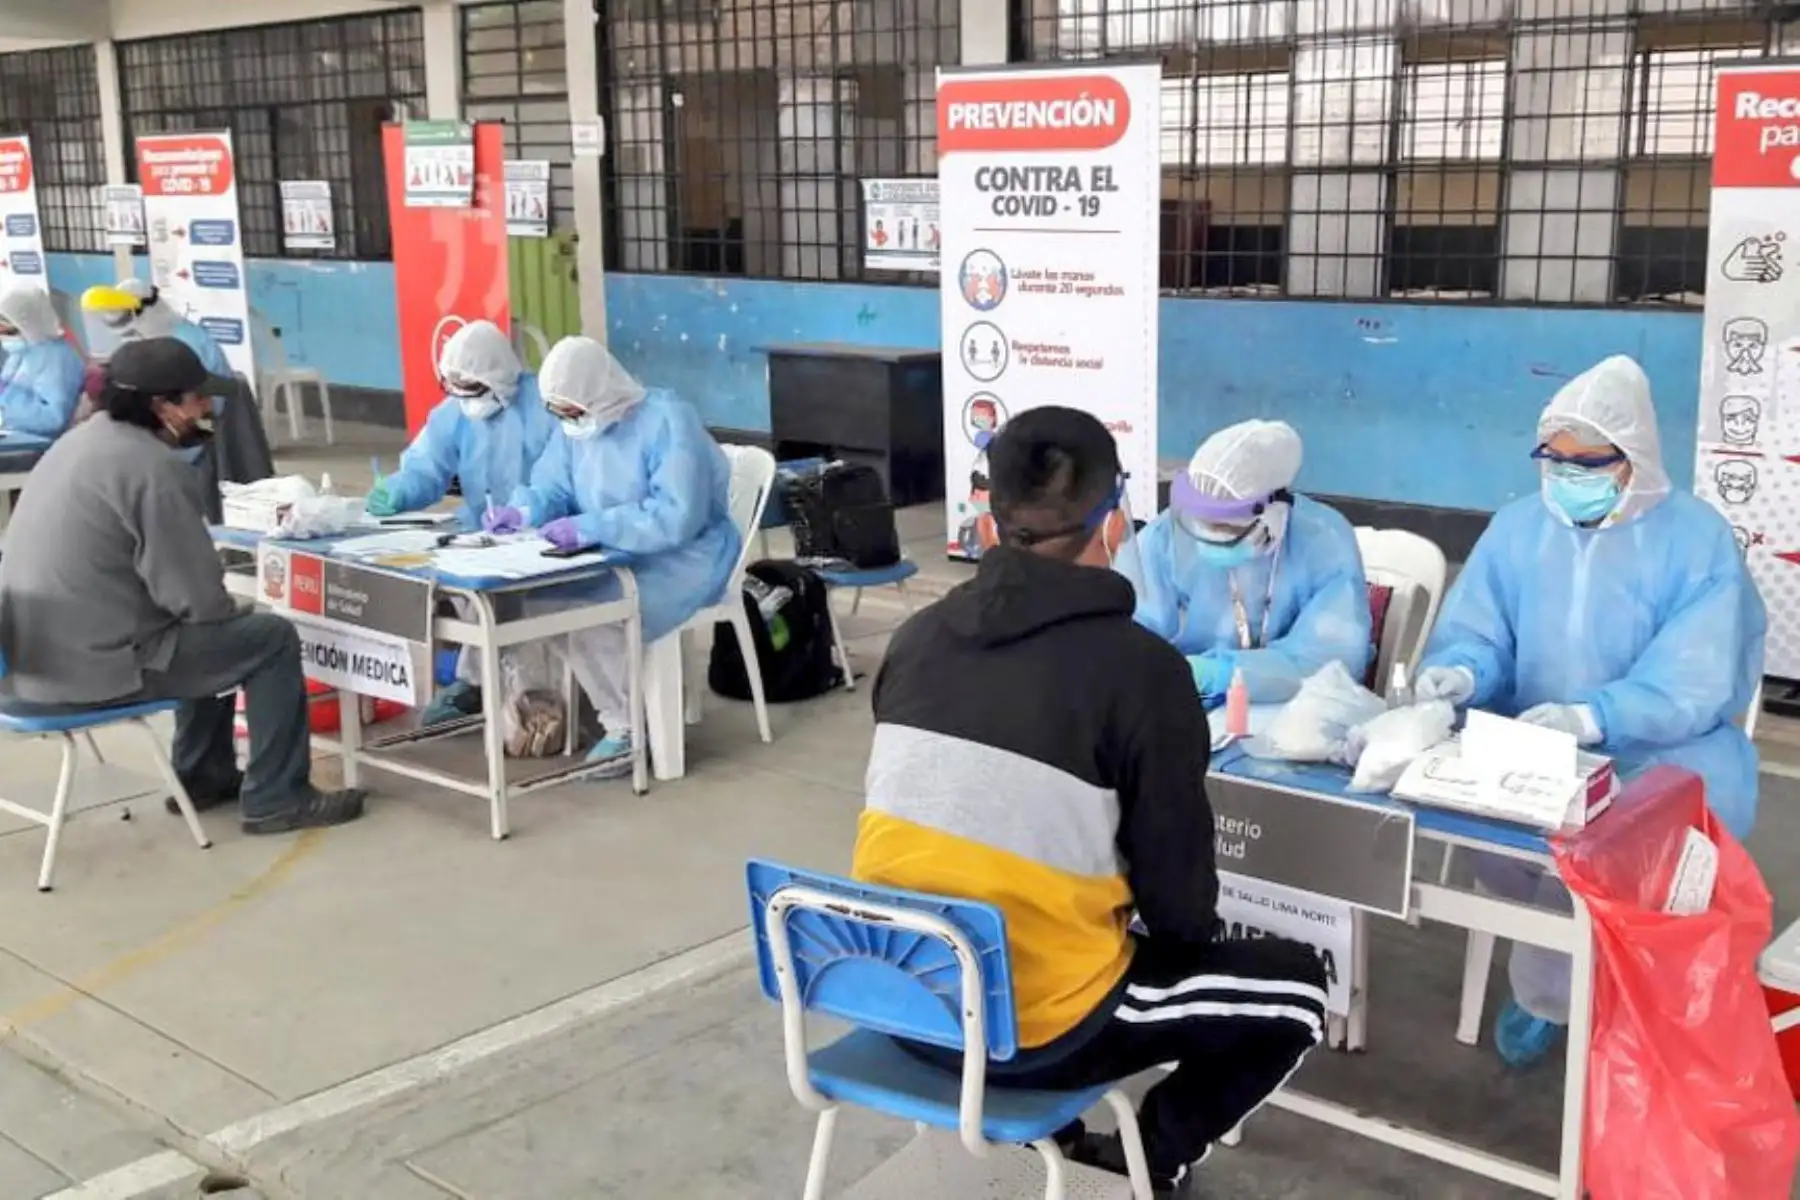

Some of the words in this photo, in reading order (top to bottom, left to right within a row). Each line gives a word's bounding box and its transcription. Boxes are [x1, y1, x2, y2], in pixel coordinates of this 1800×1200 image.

[948, 92, 1116, 129] PREVENCIÓN
[1734, 91, 1800, 120] Rec
[974, 165, 1083, 193] CONTRA
[1090, 165, 1119, 192] EL
[991, 195, 1058, 217] COVID
[1077, 195, 1101, 217] 19
[352, 652, 409, 688] MEDICA
[1272, 899, 1298, 915] LIMA
